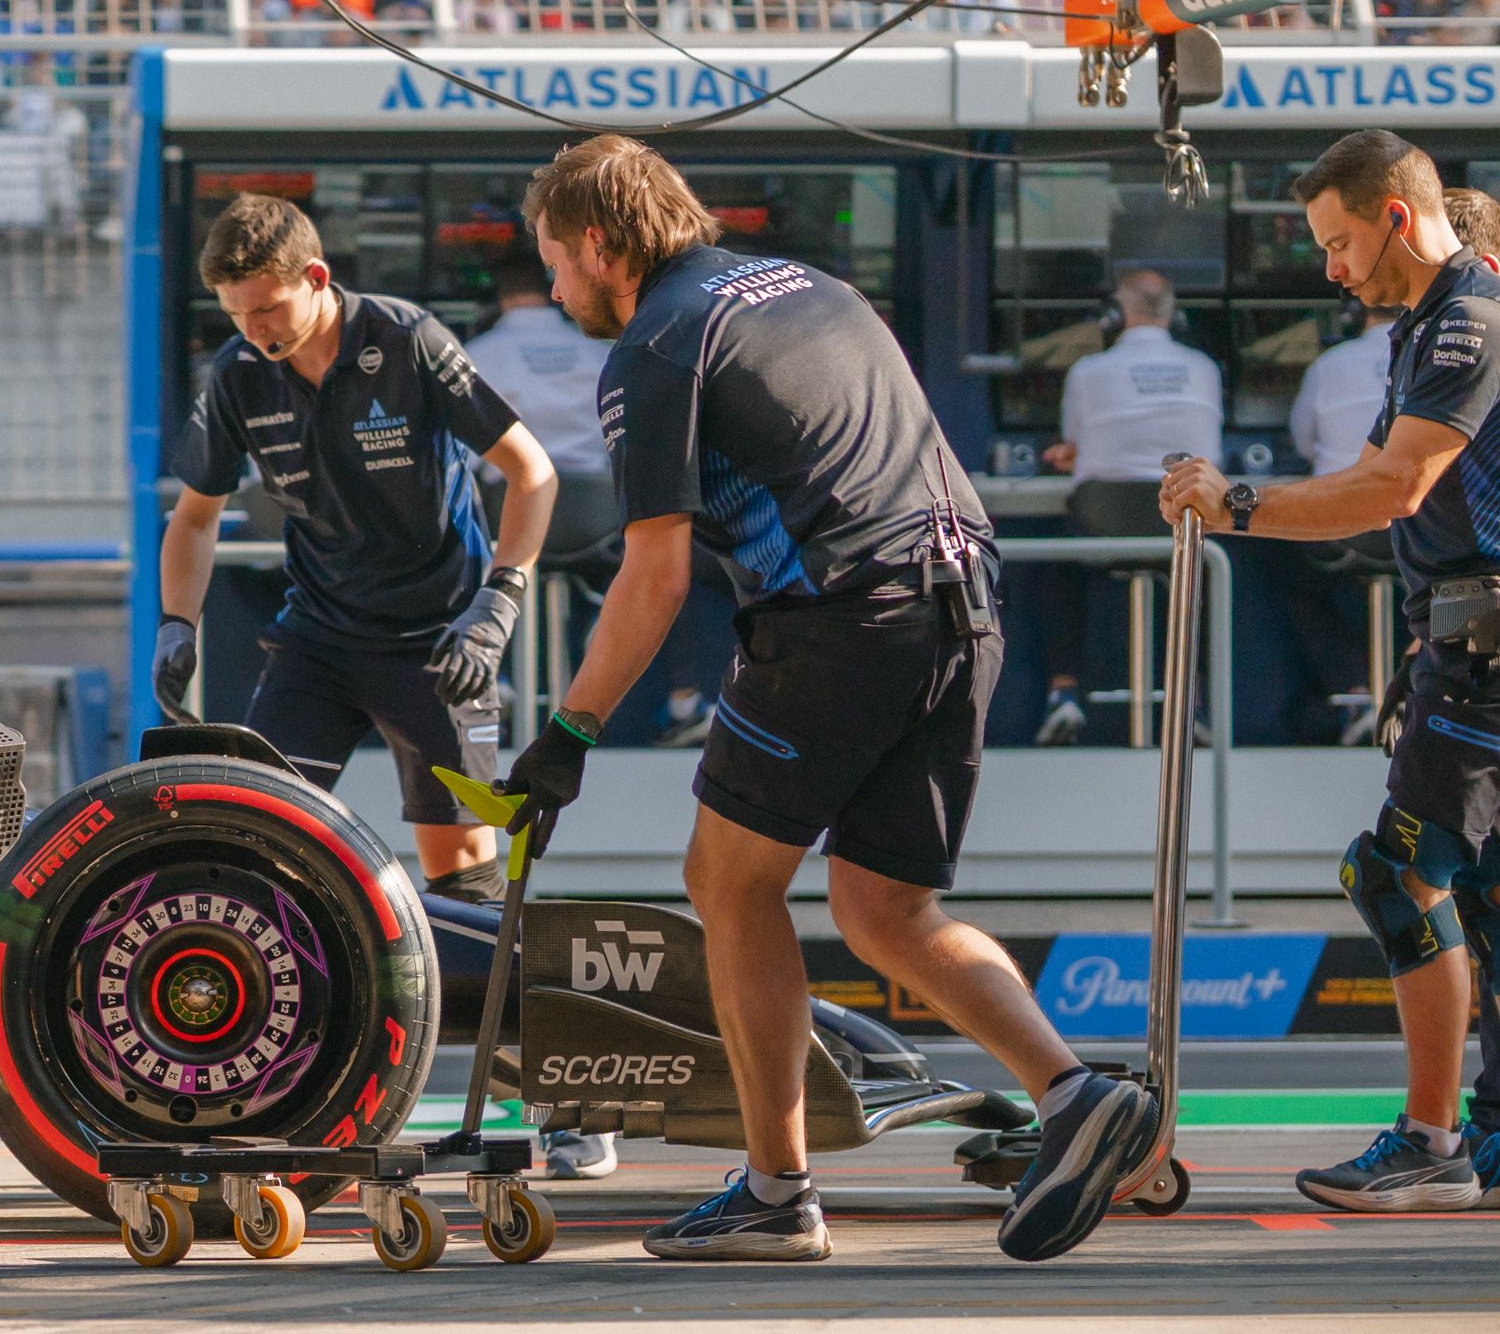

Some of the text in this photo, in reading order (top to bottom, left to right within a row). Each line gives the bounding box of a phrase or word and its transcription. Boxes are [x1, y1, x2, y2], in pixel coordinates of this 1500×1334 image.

[438, 67, 770, 108] ATLASSIAN
[700, 257, 789, 294] ATLASSIAN
[704, 264, 806, 298] WILLIAMS
[741, 276, 813, 306] RACING
[1449, 320, 1487, 331] KEEPER
[1437, 332, 1484, 349] PIRELLI
[353, 416, 407, 432] ATLASSIAN
[353, 426, 410, 443] WILLIAMS
[362, 437, 405, 452] RACING
[12, 799, 115, 900] PIRELLI
[183, 903, 194, 912] 23
[198, 903, 208, 911] 10
[155, 911, 166, 921] 30
[227, 908, 238, 918] 24
[142, 918, 153, 929] 11
[240, 915, 251, 925] 16
[131, 928, 142, 938] 36
[252, 923, 263, 934] 33
[122, 939, 132, 950] 13
[271, 946, 281, 957] 20
[115, 952, 125, 963] 27
[277, 959, 287, 970] 14
[281, 974, 290, 984] 31
[108, 980, 116, 991] 34
[108, 995, 116, 1005] 17
[281, 1003, 290, 1013] 22
[110, 1009, 119, 1020] 25
[277, 1017, 286, 1028] 18
[270, 1030, 280, 1041] 29
[384, 1016, 407, 1066] P
[121, 1036, 132, 1047] 21
[141, 1057, 152, 1068] 19
[251, 1053, 262, 1064] 28
[154, 1065, 165, 1075] 15
[239, 1062, 250, 1072] 12
[536, 1053, 695, 1085] SCORES
[168, 1071, 179, 1080] 32
[226, 1068, 237, 1078] 35
[197, 1075, 208, 1084] 26
